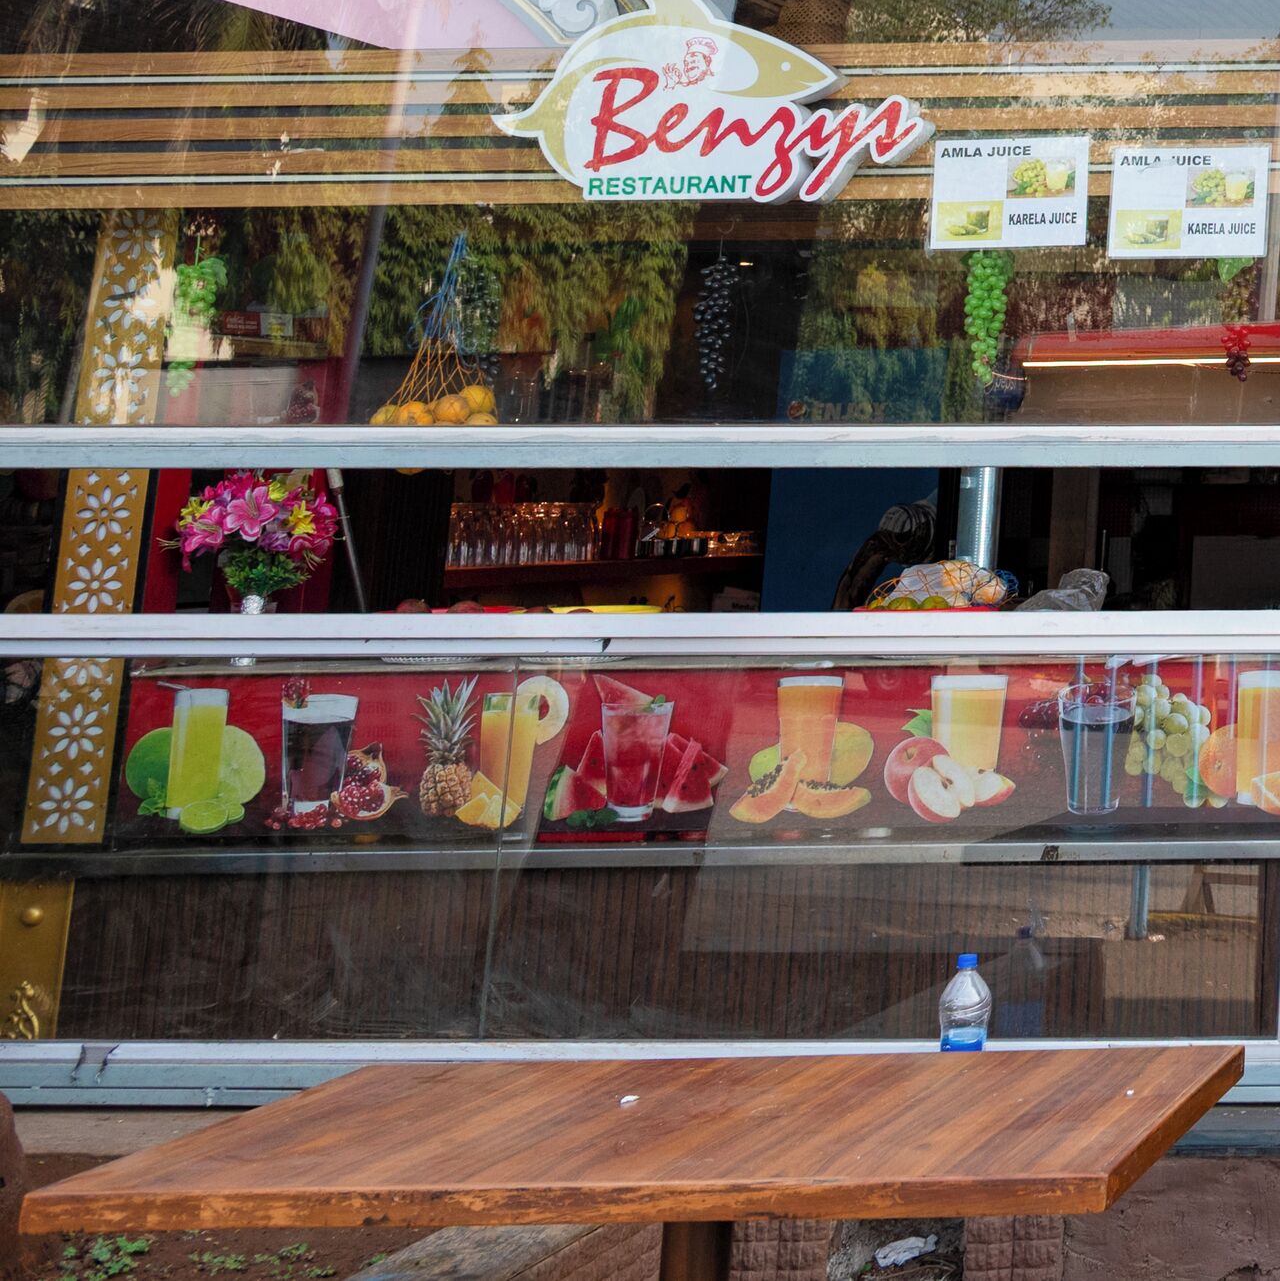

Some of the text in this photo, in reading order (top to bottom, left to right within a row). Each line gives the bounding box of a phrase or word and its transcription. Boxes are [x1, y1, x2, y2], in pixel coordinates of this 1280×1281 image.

[584, 67, 918, 198] Benzys
[940, 145, 1032, 159] AMLA JUICE
[1171, 155, 1212, 167] UICE
[588, 174, 752, 196] RESTAURANT
[1008, 211, 1078, 226] KARELA JUICE
[1187, 221, 1257, 236] KARELA JUICE
